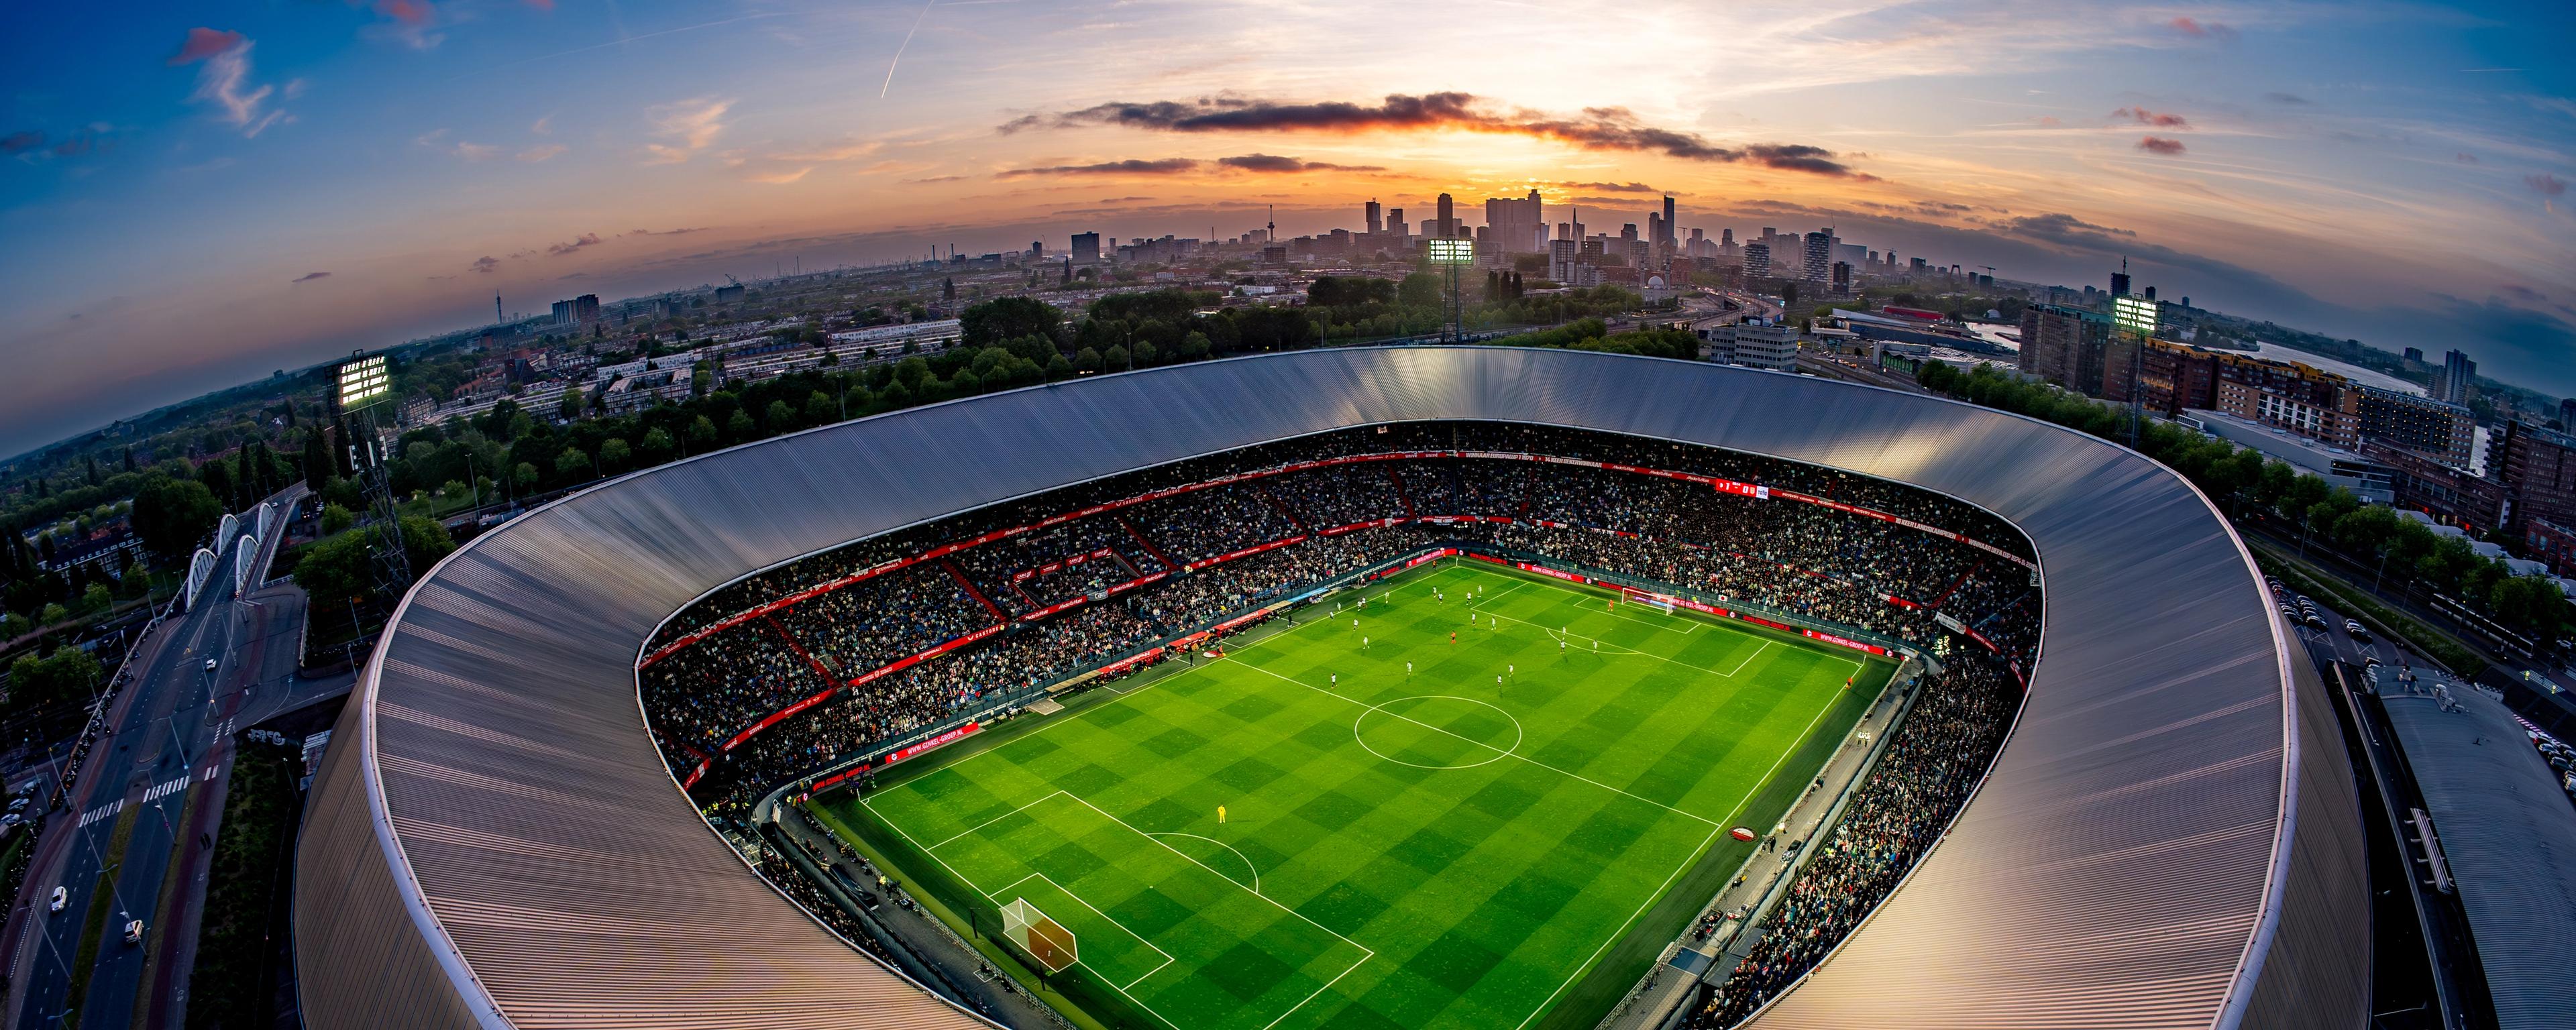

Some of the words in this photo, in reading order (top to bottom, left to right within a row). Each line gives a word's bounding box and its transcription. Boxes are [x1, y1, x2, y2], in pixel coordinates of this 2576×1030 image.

[1563, 459, 1602, 468] BEKERWINNAAR
[1726, 482, 1730, 490] 1
[1743, 485, 1749, 494] 0
[1161, 490, 1181, 498] CASTORE
[1122, 497, 1143, 505] CASTORE
[1901, 520, 1913, 528] KEER
[1914, 522, 1956, 539] LANDSKAMPIOEN
[1968, 538, 1991, 552] WINNAAR
[1990, 547, 2002, 556] UEFA
[2011, 555, 2021, 564] 1974
[1532, 566, 1572, 581] WWW.GINKEL-GROEP.NL
[975, 626, 999, 638] CASTORE
[1820, 634, 1870, 651] WWW.GINKEL-GROEP.NL
[785, 703, 804, 716] BREEMAN
[749, 722, 763, 735] univé
[907, 728, 964, 755] WWW.GINKEL-GROEP.NL
